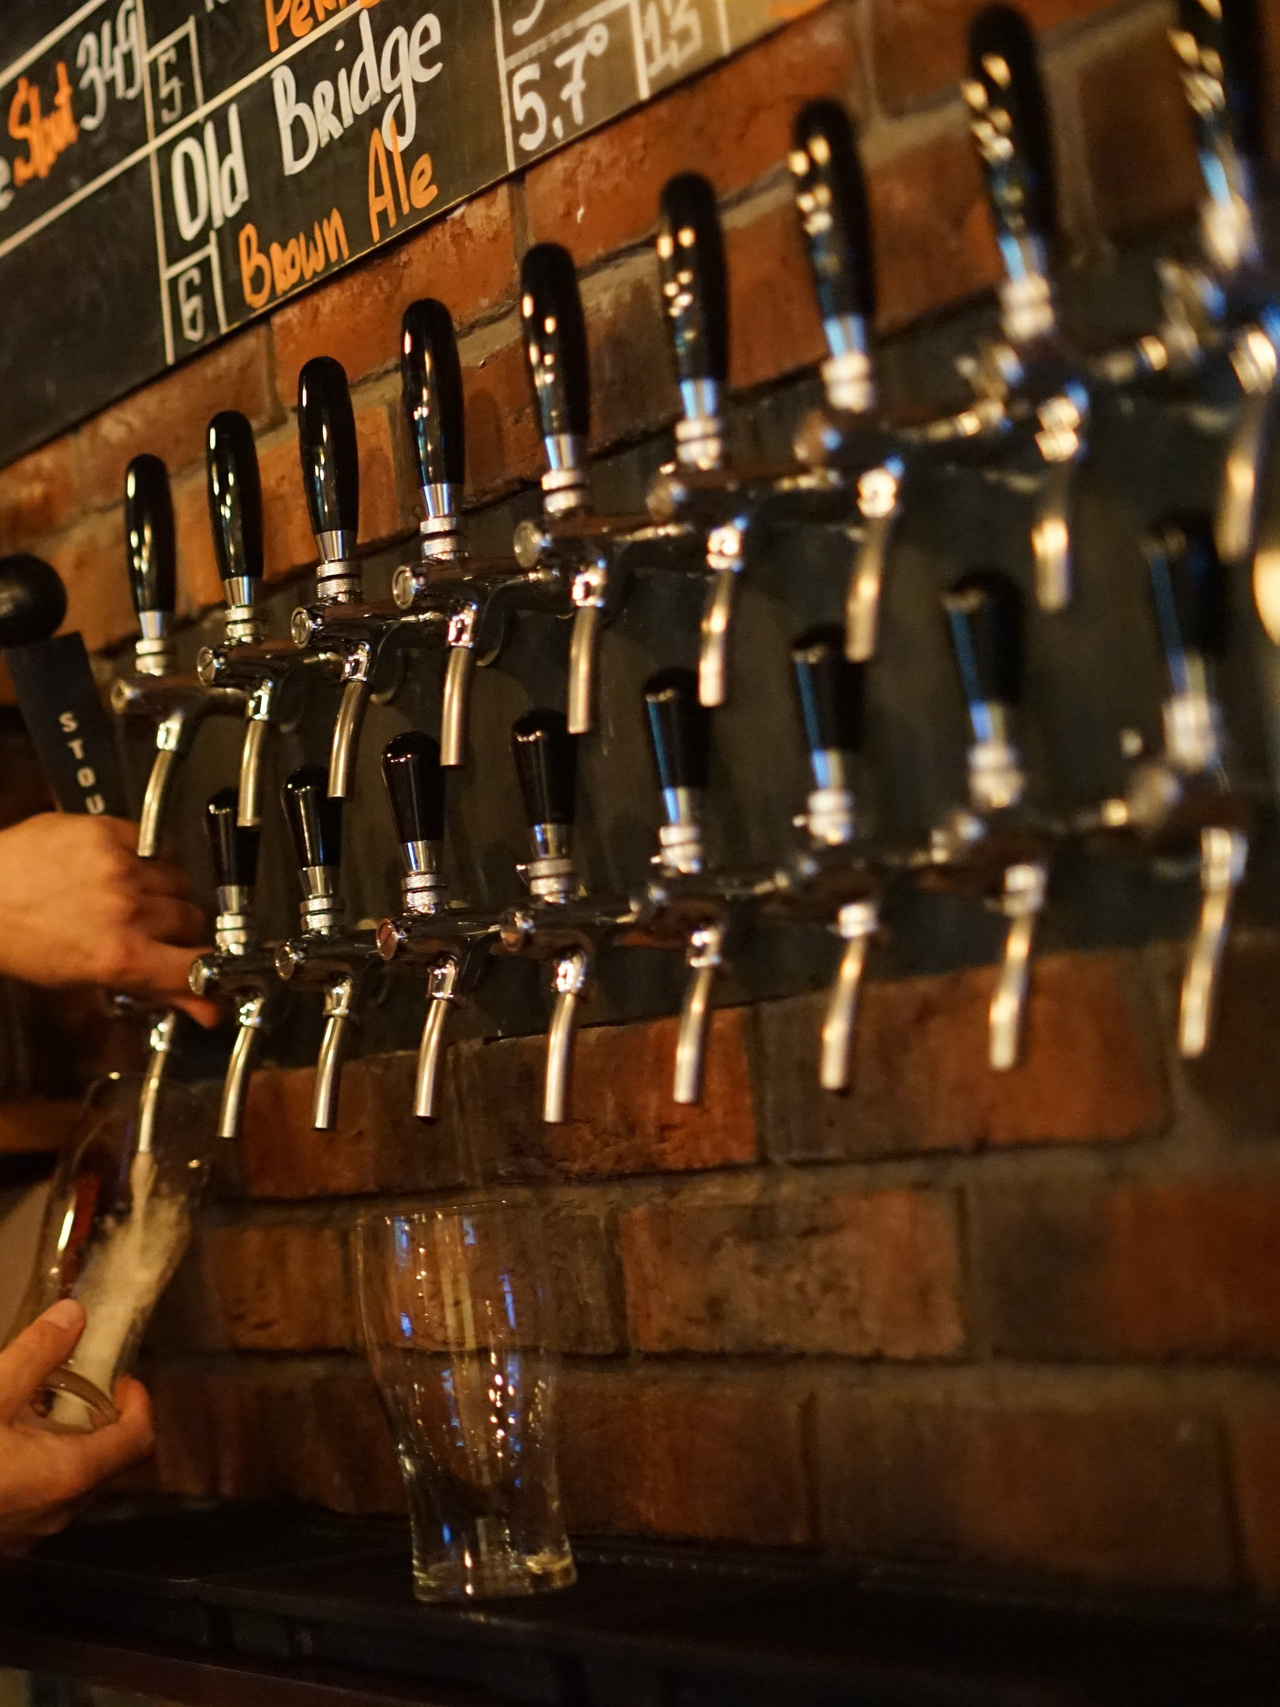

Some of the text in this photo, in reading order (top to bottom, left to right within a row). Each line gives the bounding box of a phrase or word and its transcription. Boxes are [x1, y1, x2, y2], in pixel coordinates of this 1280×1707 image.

[158, 47, 184, 124] 5
[171, 103, 249, 241] Old
[368, 119, 439, 242] Ale
